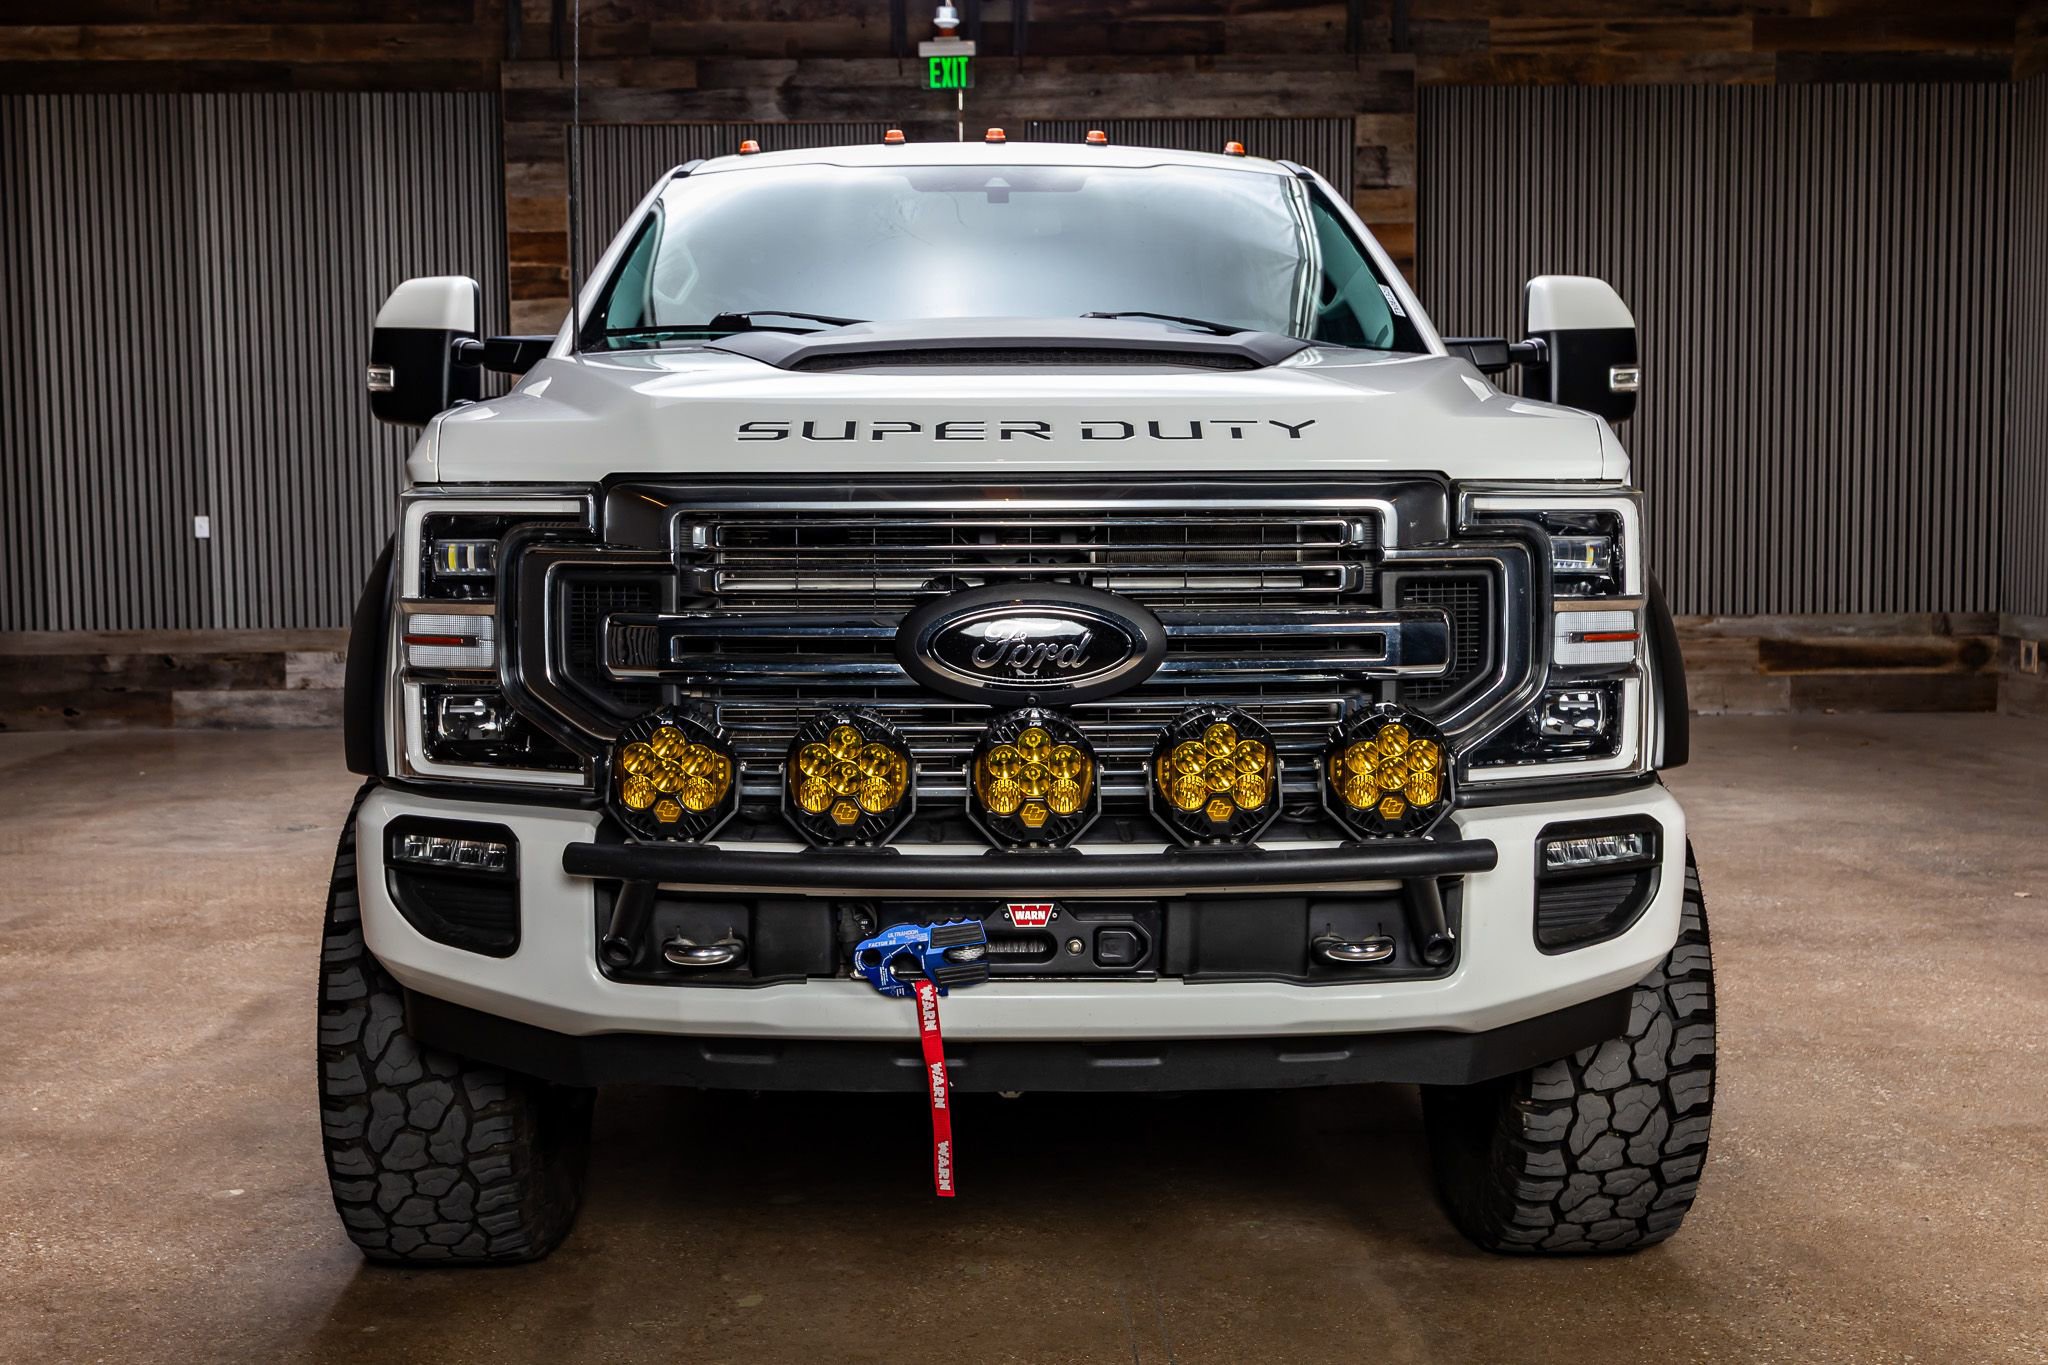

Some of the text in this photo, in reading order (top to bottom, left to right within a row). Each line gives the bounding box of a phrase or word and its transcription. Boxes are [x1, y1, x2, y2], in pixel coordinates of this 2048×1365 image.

[929, 56, 968, 88] EXIT
[737, 419, 1315, 441] SUPER DUTY
[971, 620, 1093, 669] Ford
[1015, 910, 1046, 920] WARN
[868, 940, 888, 948] FACTOR
[920, 984, 937, 1032] WARN
[930, 1061, 946, 1109] WARN
[937, 1140, 951, 1191] WARN
